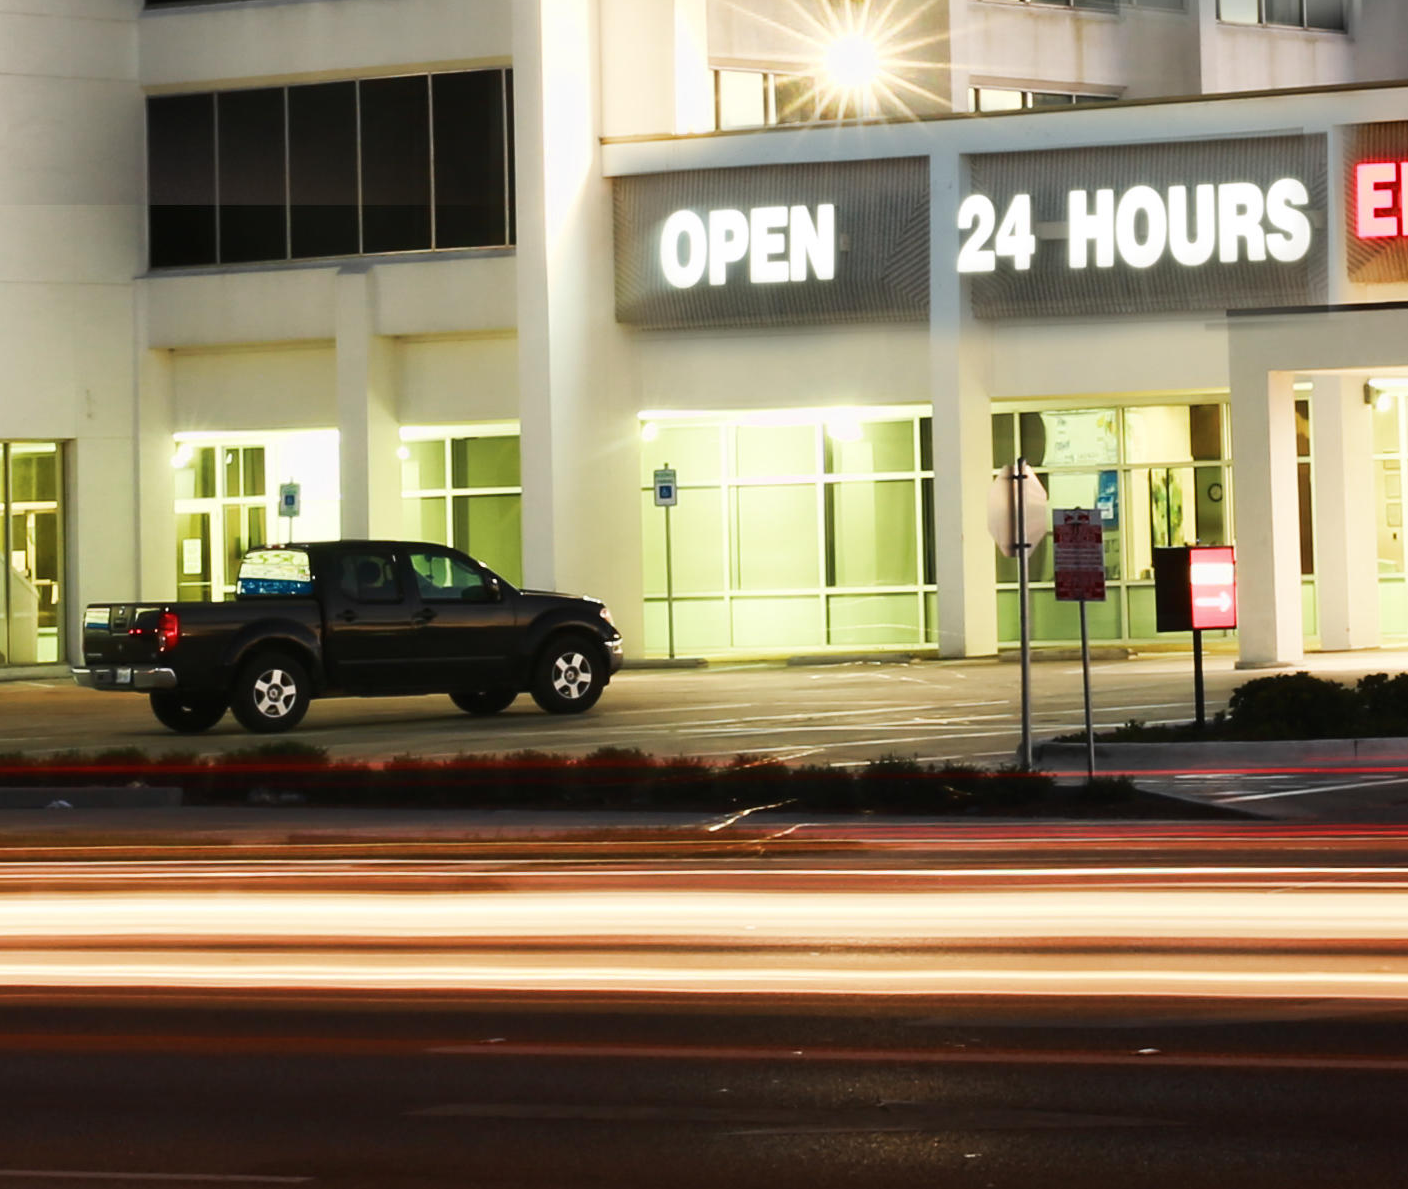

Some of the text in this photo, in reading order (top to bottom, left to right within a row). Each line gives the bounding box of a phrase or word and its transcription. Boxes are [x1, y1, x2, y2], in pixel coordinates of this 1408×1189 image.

[659, 203, 836, 290] OPEN
[956, 178, 1313, 273] 24 HOURS
